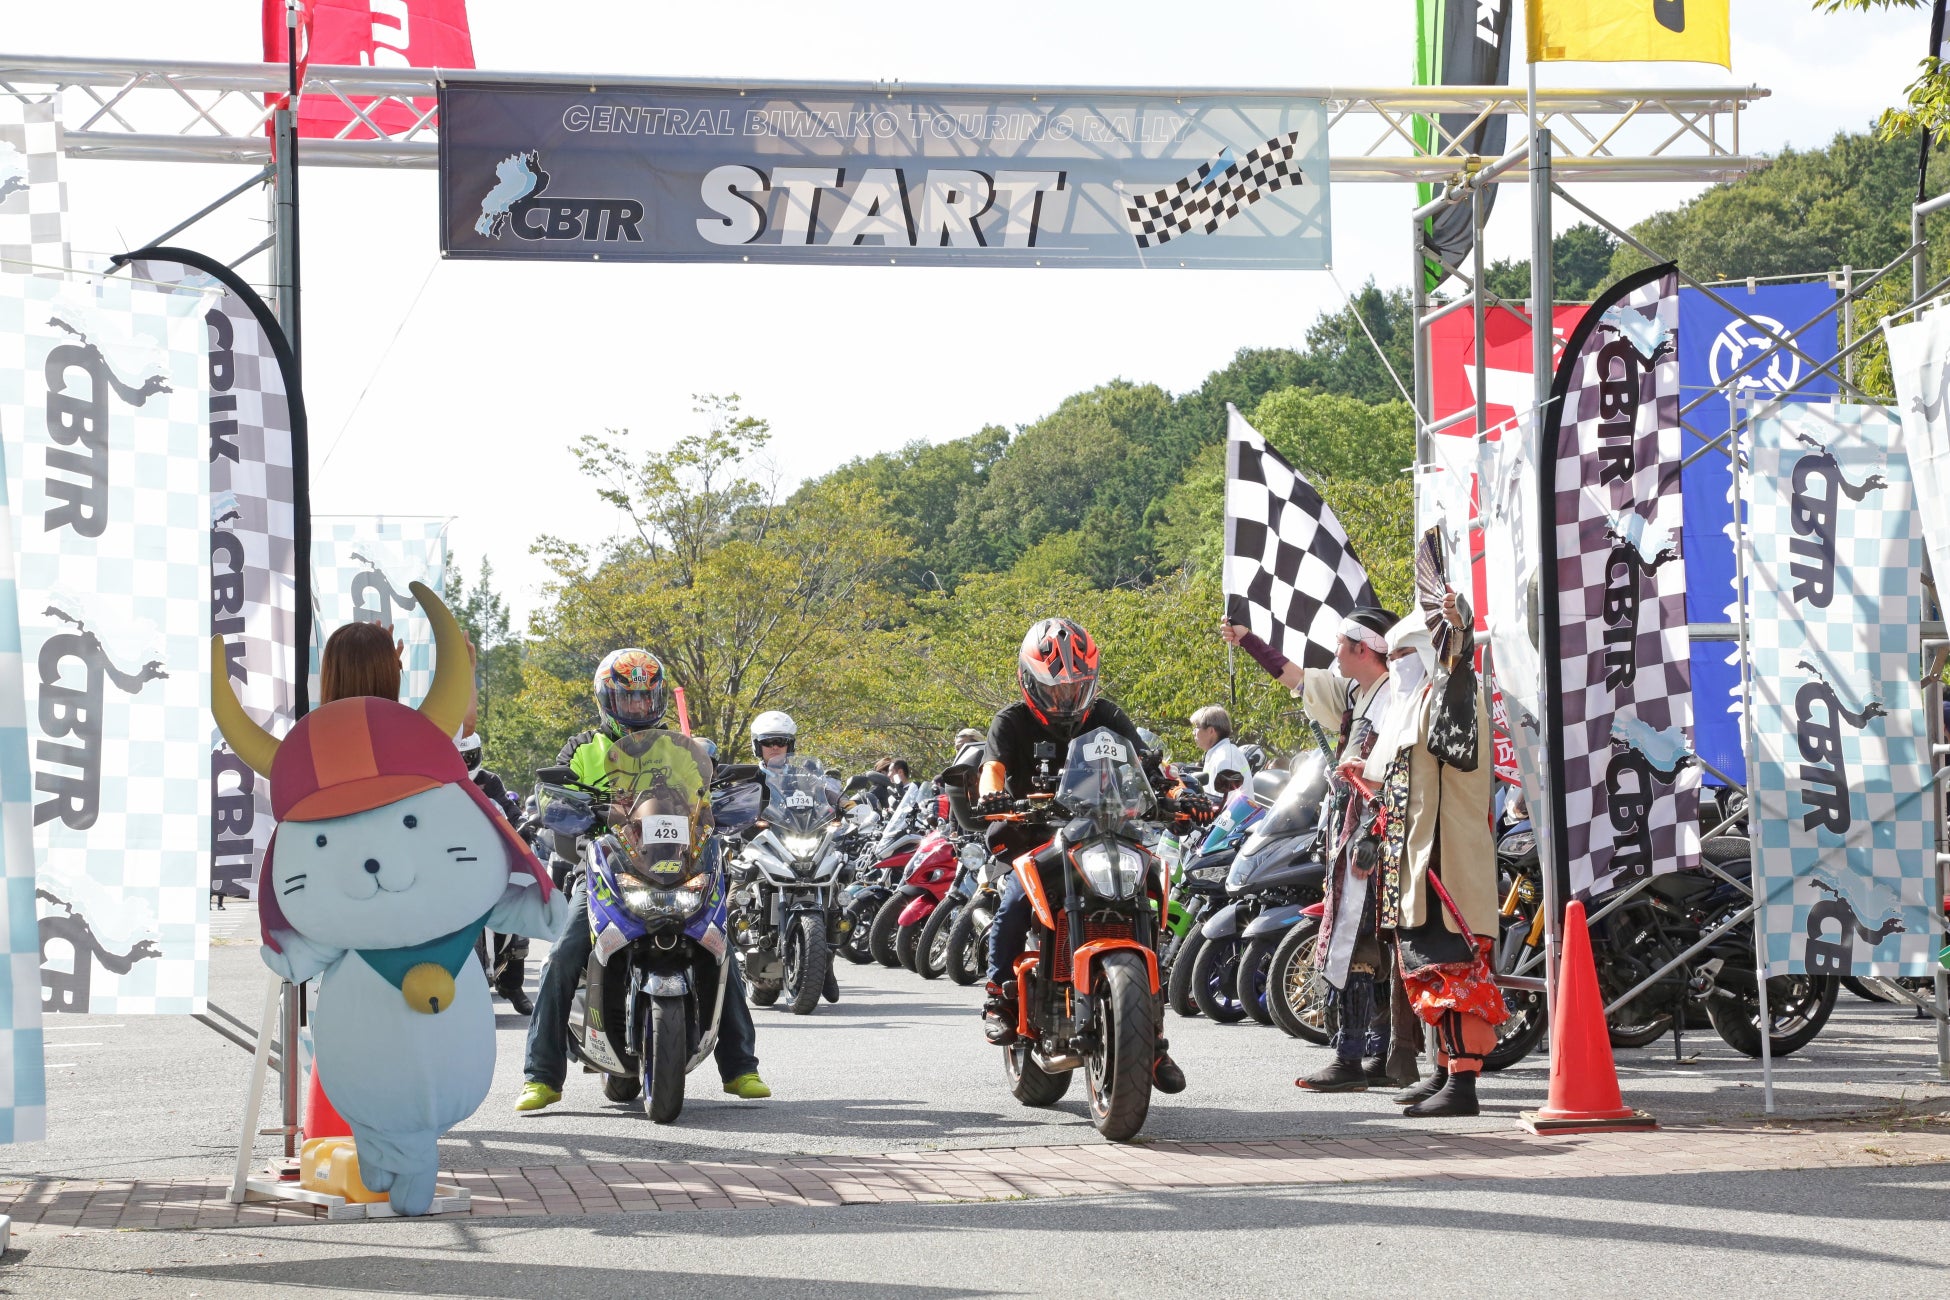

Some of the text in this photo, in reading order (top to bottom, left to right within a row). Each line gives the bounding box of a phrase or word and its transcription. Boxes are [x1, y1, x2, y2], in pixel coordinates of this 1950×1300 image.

[562, 104, 1194, 143] CENTRAL BIWAKO TOURING RALLY
[509, 197, 645, 242] CBTR
[696, 164, 1067, 248] START
[44, 344, 109, 538] CBTR
[1596, 338, 1640, 488] CBTR
[1789, 454, 1839, 609] CBTR
[1602, 546, 1641, 694] CBTR
[33, 633, 105, 831] CBTR
[1094, 744, 1118, 757] 428
[1794, 682, 1852, 835] CBTR
[654, 828, 679, 839] 429
